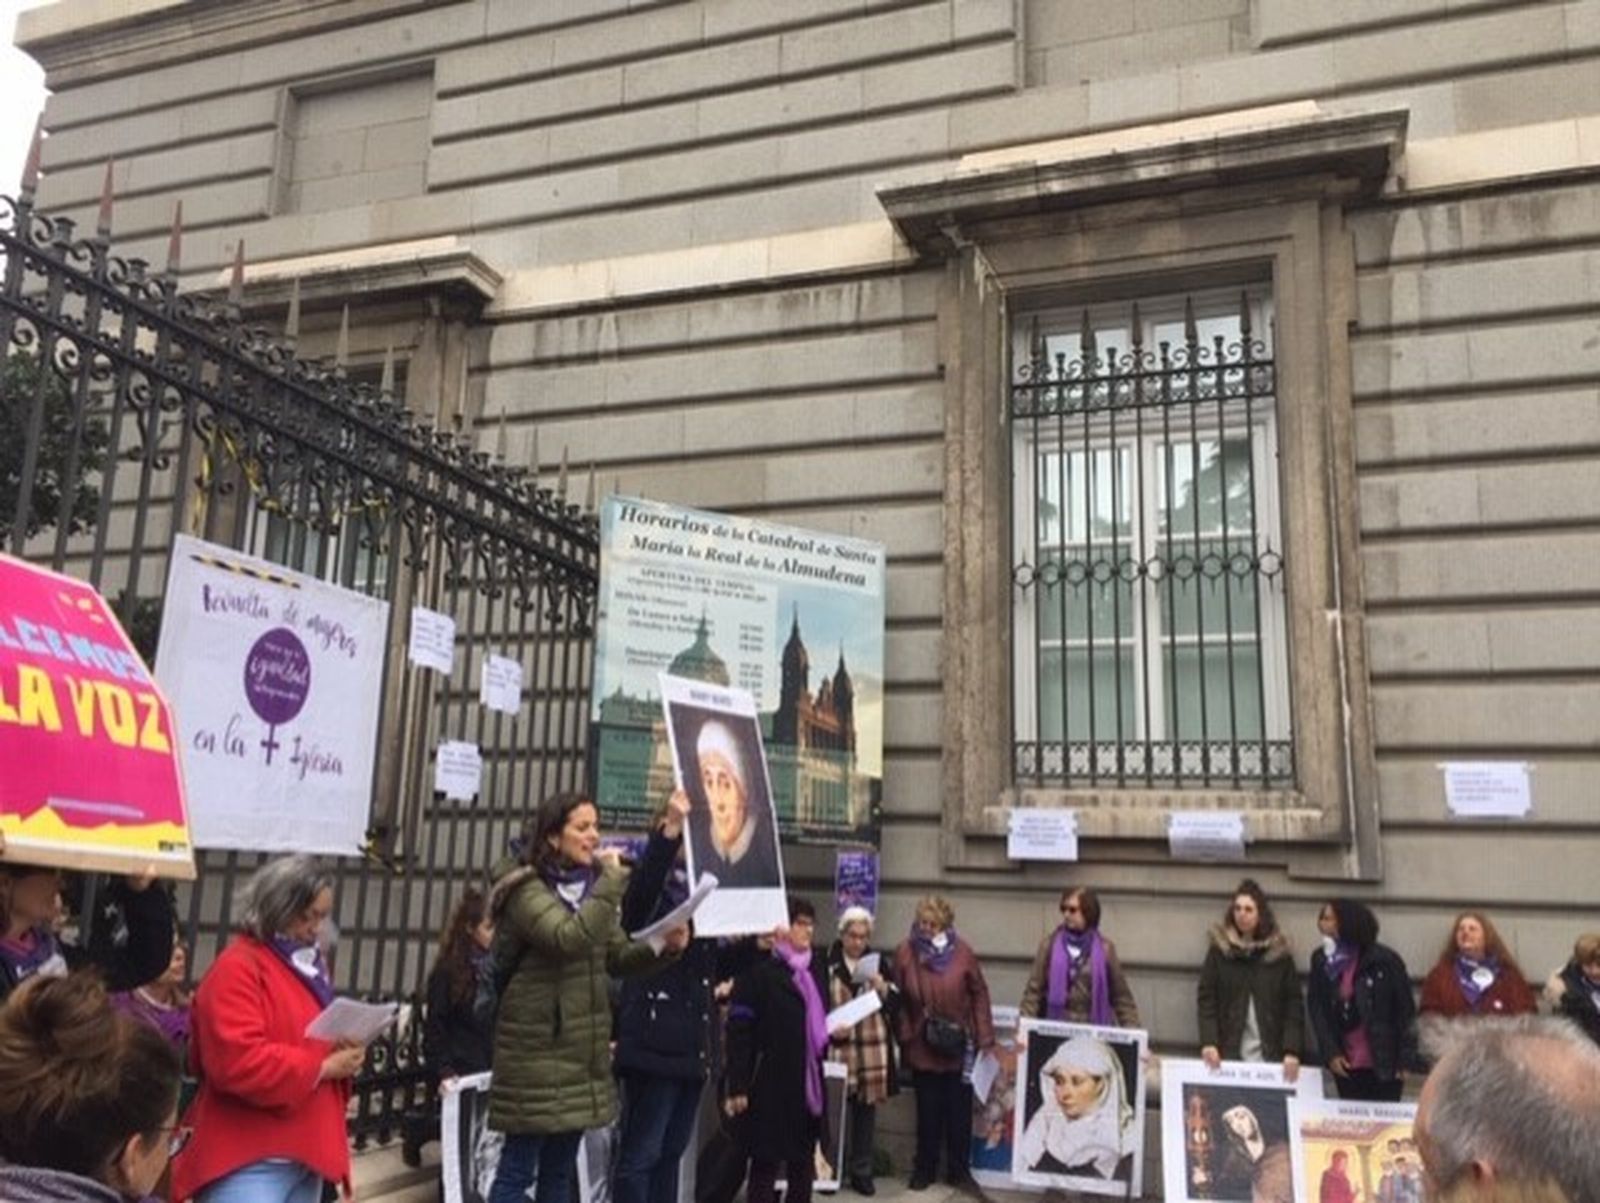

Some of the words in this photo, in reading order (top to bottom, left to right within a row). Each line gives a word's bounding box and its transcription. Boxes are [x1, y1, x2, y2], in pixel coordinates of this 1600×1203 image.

[620, 505, 710, 535] Horarios
[712, 524, 730, 538] de
[732, 527, 745, 540] la
[747, 529, 815, 553] Catedral
[816, 543, 831, 556] de
[834, 546, 876, 565] Santa
[687, 545, 701, 559] la
[704, 546, 743, 565] Real
[744, 554, 760, 568] de
[762, 557, 776, 571] la
[778, 558, 866, 587] Almudena
[0, 614, 154, 686] LCEMOS
[0, 662, 63, 732] LA
[64, 673, 171, 755] VOZ
[193, 728, 216, 754] en
[223, 713, 246, 758] la
[289, 735, 344, 780] Iglesia
